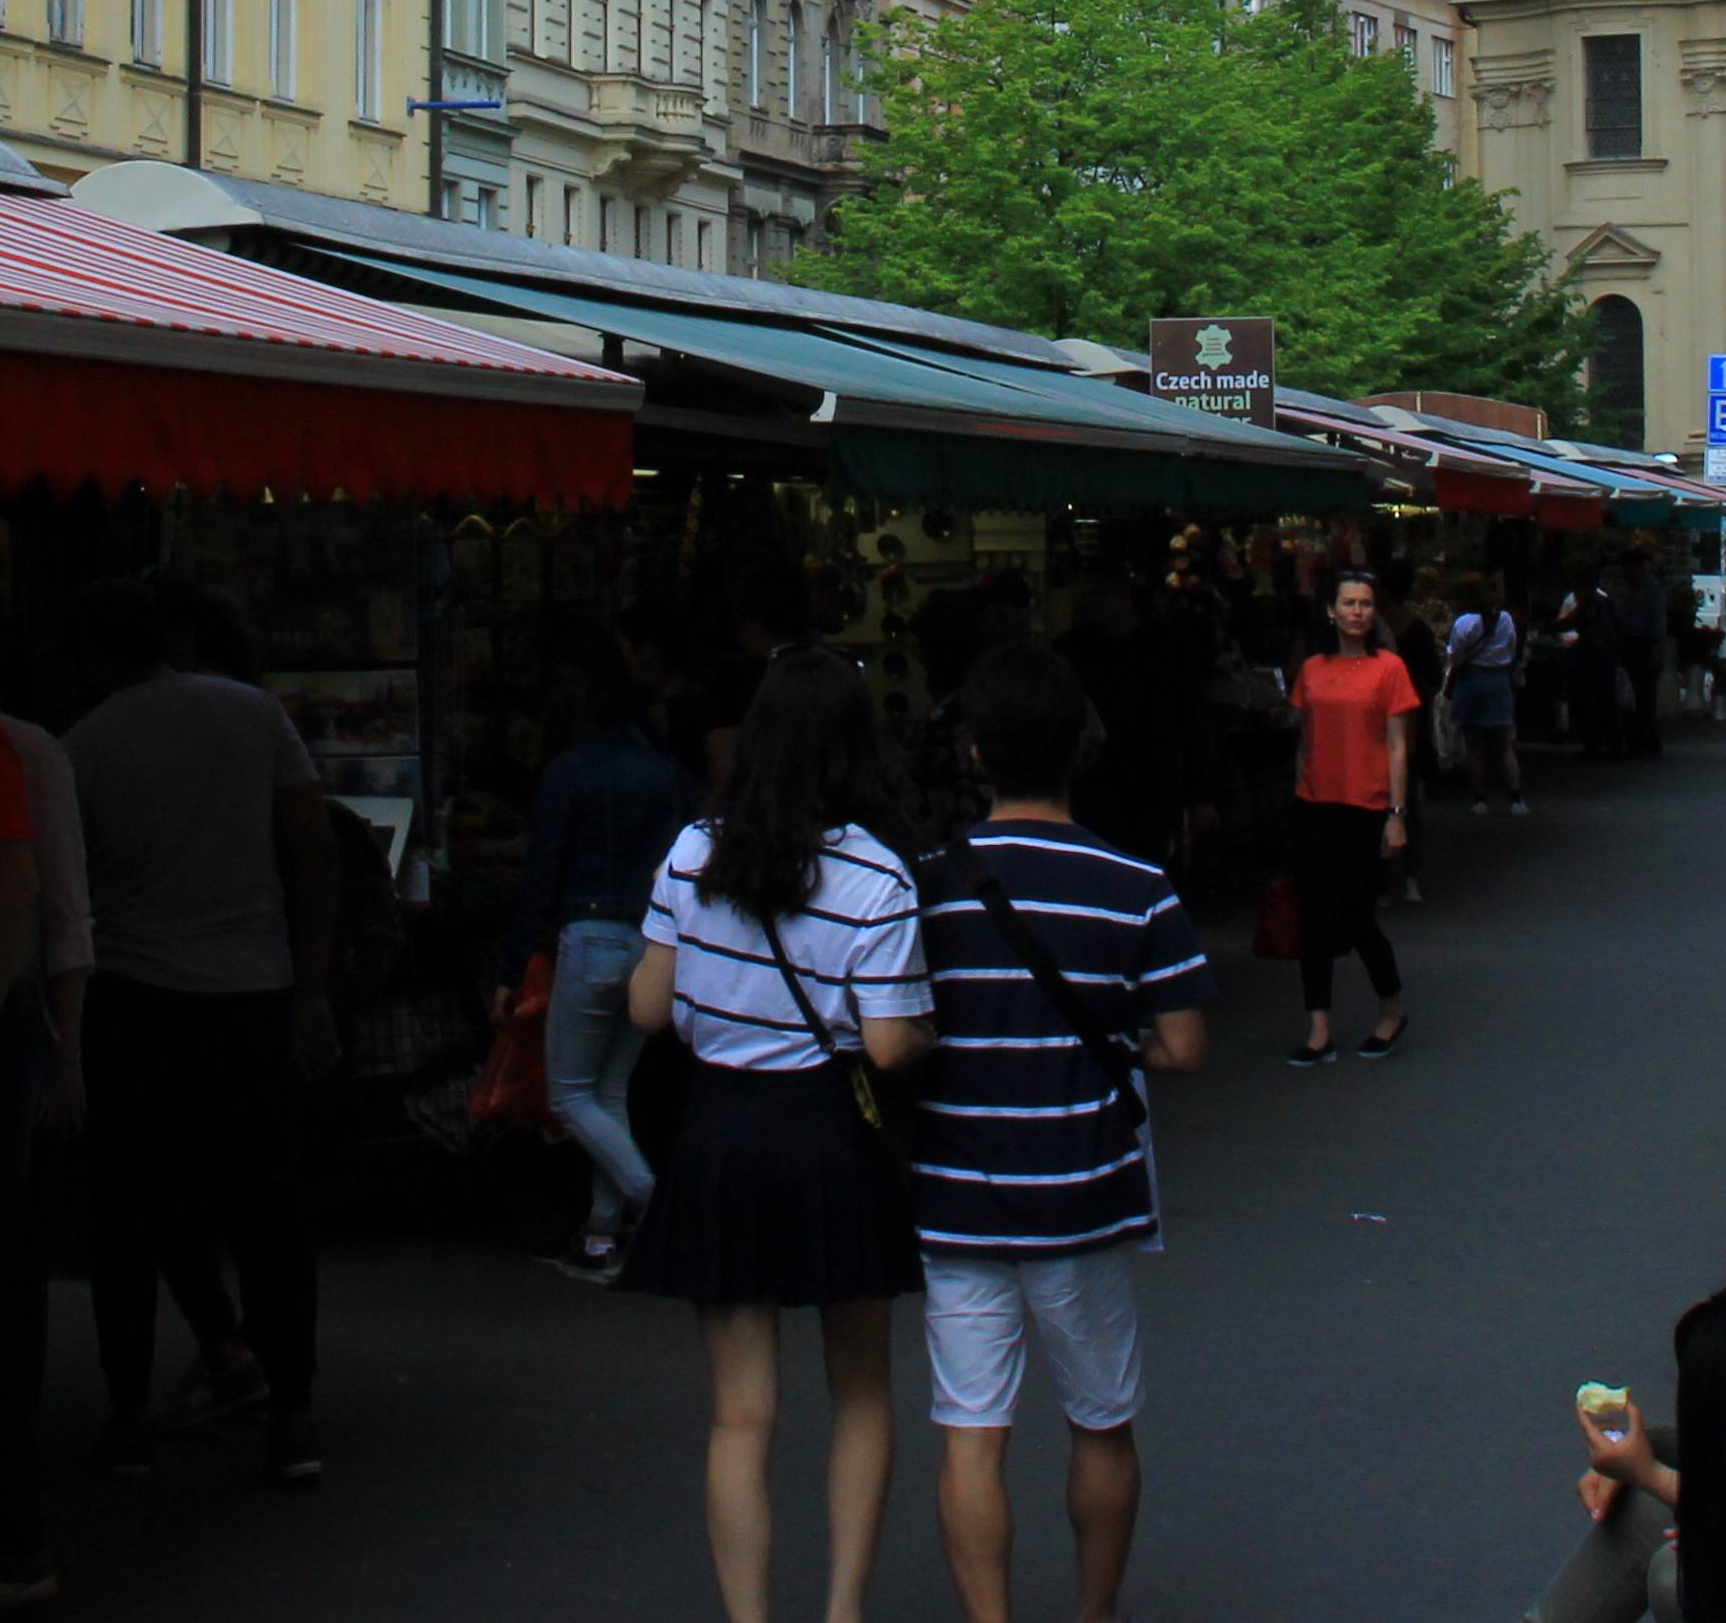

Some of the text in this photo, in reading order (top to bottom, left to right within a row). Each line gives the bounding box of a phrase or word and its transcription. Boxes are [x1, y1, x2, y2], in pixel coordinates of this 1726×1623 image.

[1155, 369, 1270, 391] Czech made
[1174, 390, 1252, 410] natural
